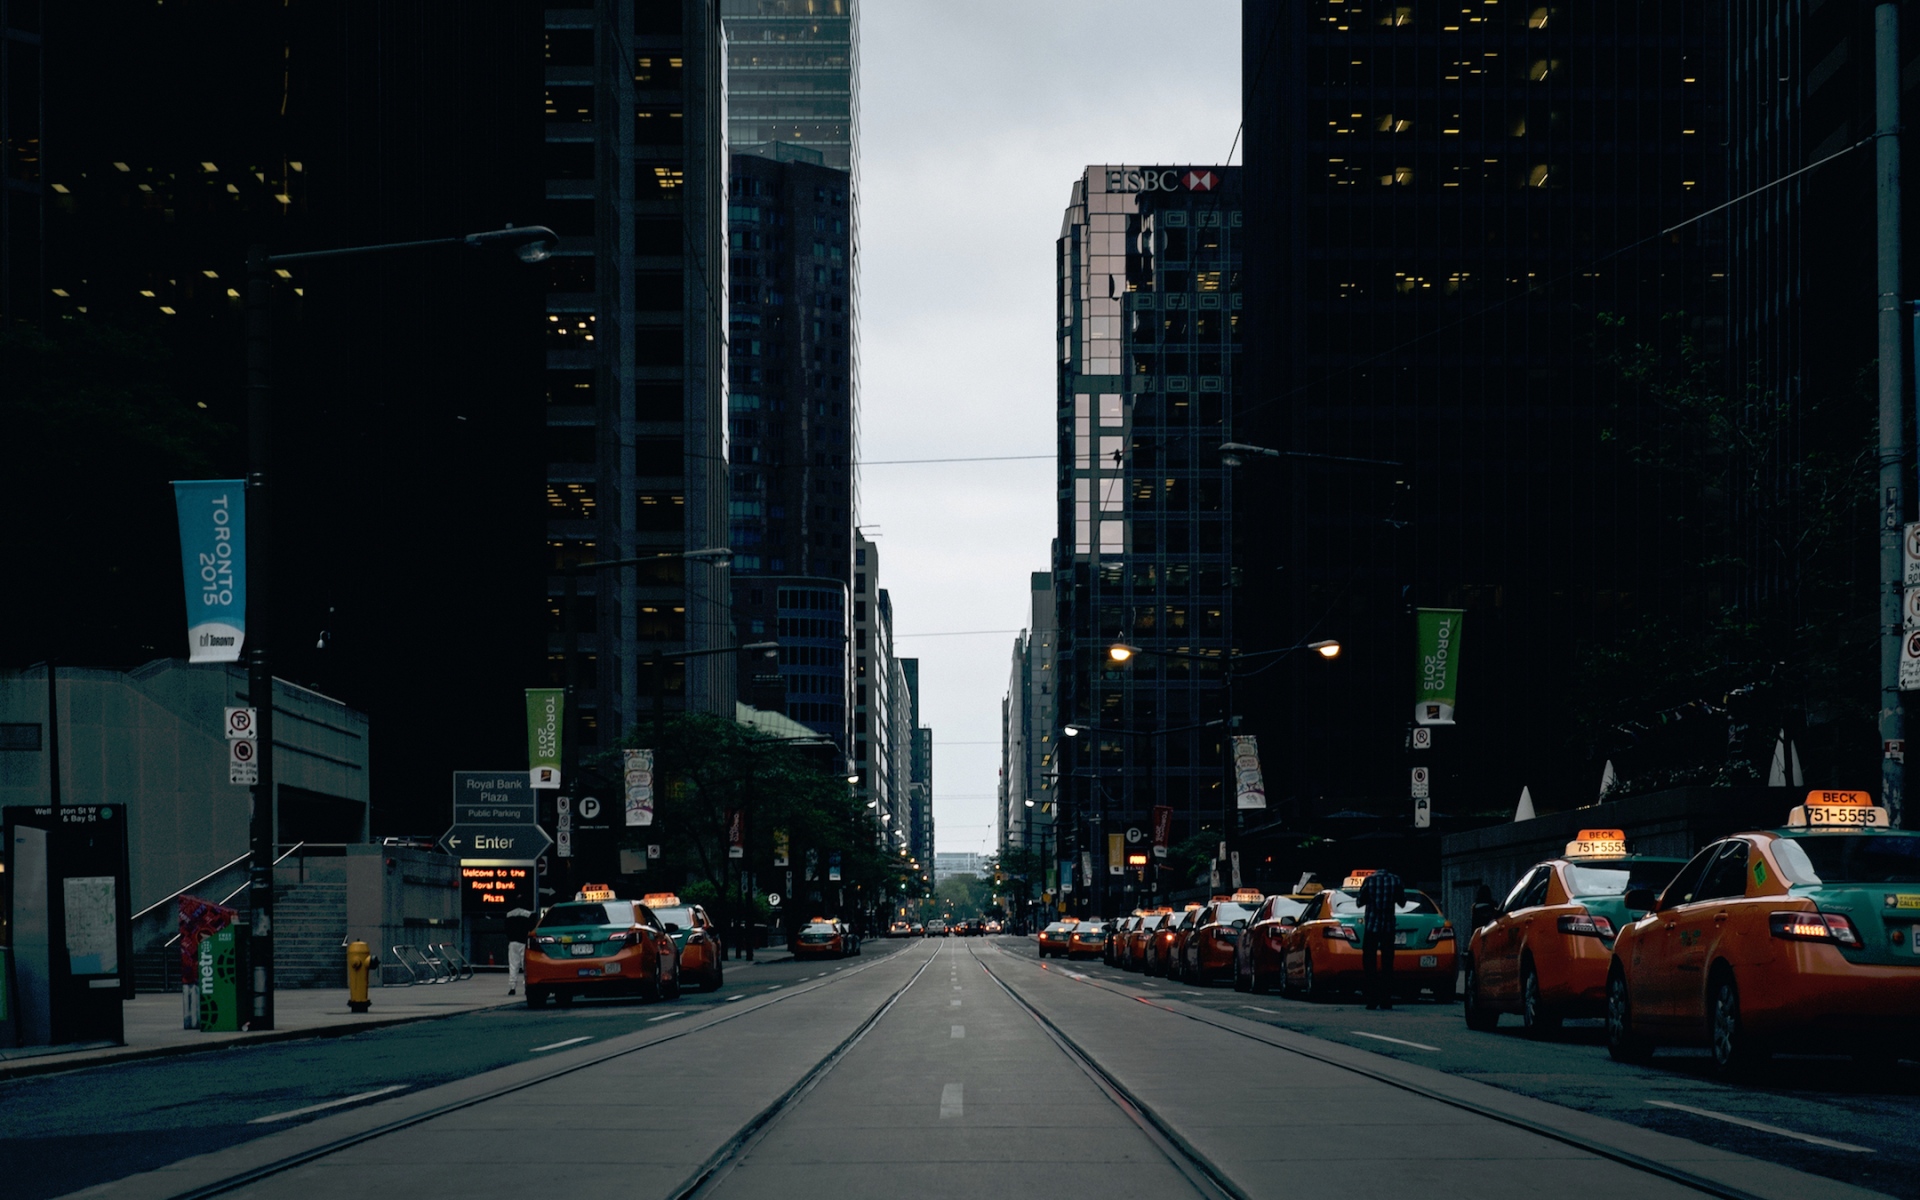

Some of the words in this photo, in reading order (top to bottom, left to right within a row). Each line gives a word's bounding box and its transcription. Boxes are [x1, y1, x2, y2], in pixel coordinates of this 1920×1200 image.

[1105, 169, 1178, 193] HSBC
[212, 494, 233, 606] TORONTO
[199, 553, 218, 606] 2015
[1435, 618, 1450, 690] TORONTO
[1423, 655, 1436, 690] 2015
[546, 697, 556, 758] TORONTO
[537, 728, 549, 758] 2015
[466, 779, 495, 791] Royal
[497, 779, 523, 789] Bank
[480, 792, 509, 802] Plaza
[1822, 792, 1857, 804] BECK
[77, 806, 86, 815] St
[88, 806, 97, 814] W
[468, 809, 491, 818] Public
[492, 809, 521, 819] Parking
[1806, 808, 1876, 823] 751-5555
[63, 815, 69, 823] &
[71, 815, 86, 824] Bay
[87, 814, 97, 823] St
[1588, 831, 1615, 840] BECK
[474, 834, 515, 850] Enter
[1577, 841, 1628, 853] 751-5555
[462, 868, 494, 878] Welcome
[496, 869, 508, 878] to
[510, 869, 526, 878] the
[472, 881, 494, 890] Royal
[495, 881, 516, 890] Bank
[482, 893, 505, 903] Plaza
